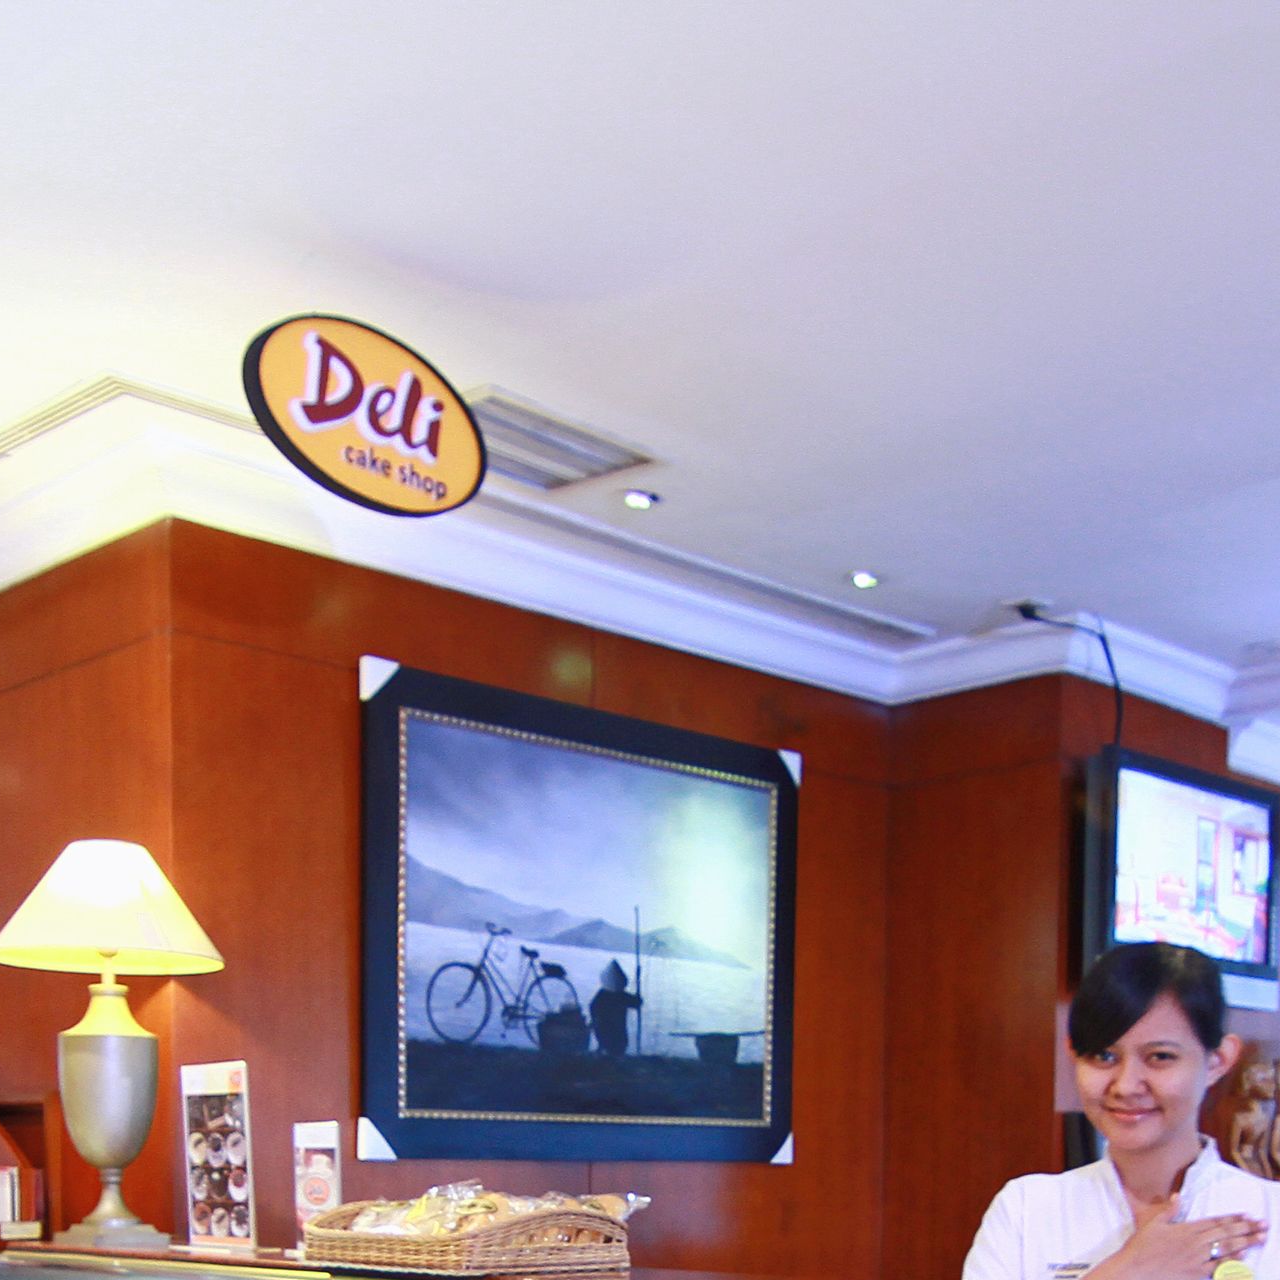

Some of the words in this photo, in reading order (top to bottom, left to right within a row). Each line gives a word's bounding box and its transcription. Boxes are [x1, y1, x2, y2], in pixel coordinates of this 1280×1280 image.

[290, 331, 445, 464] Deli
[344, 446, 392, 477] cake
[399, 464, 448, 500] shop
